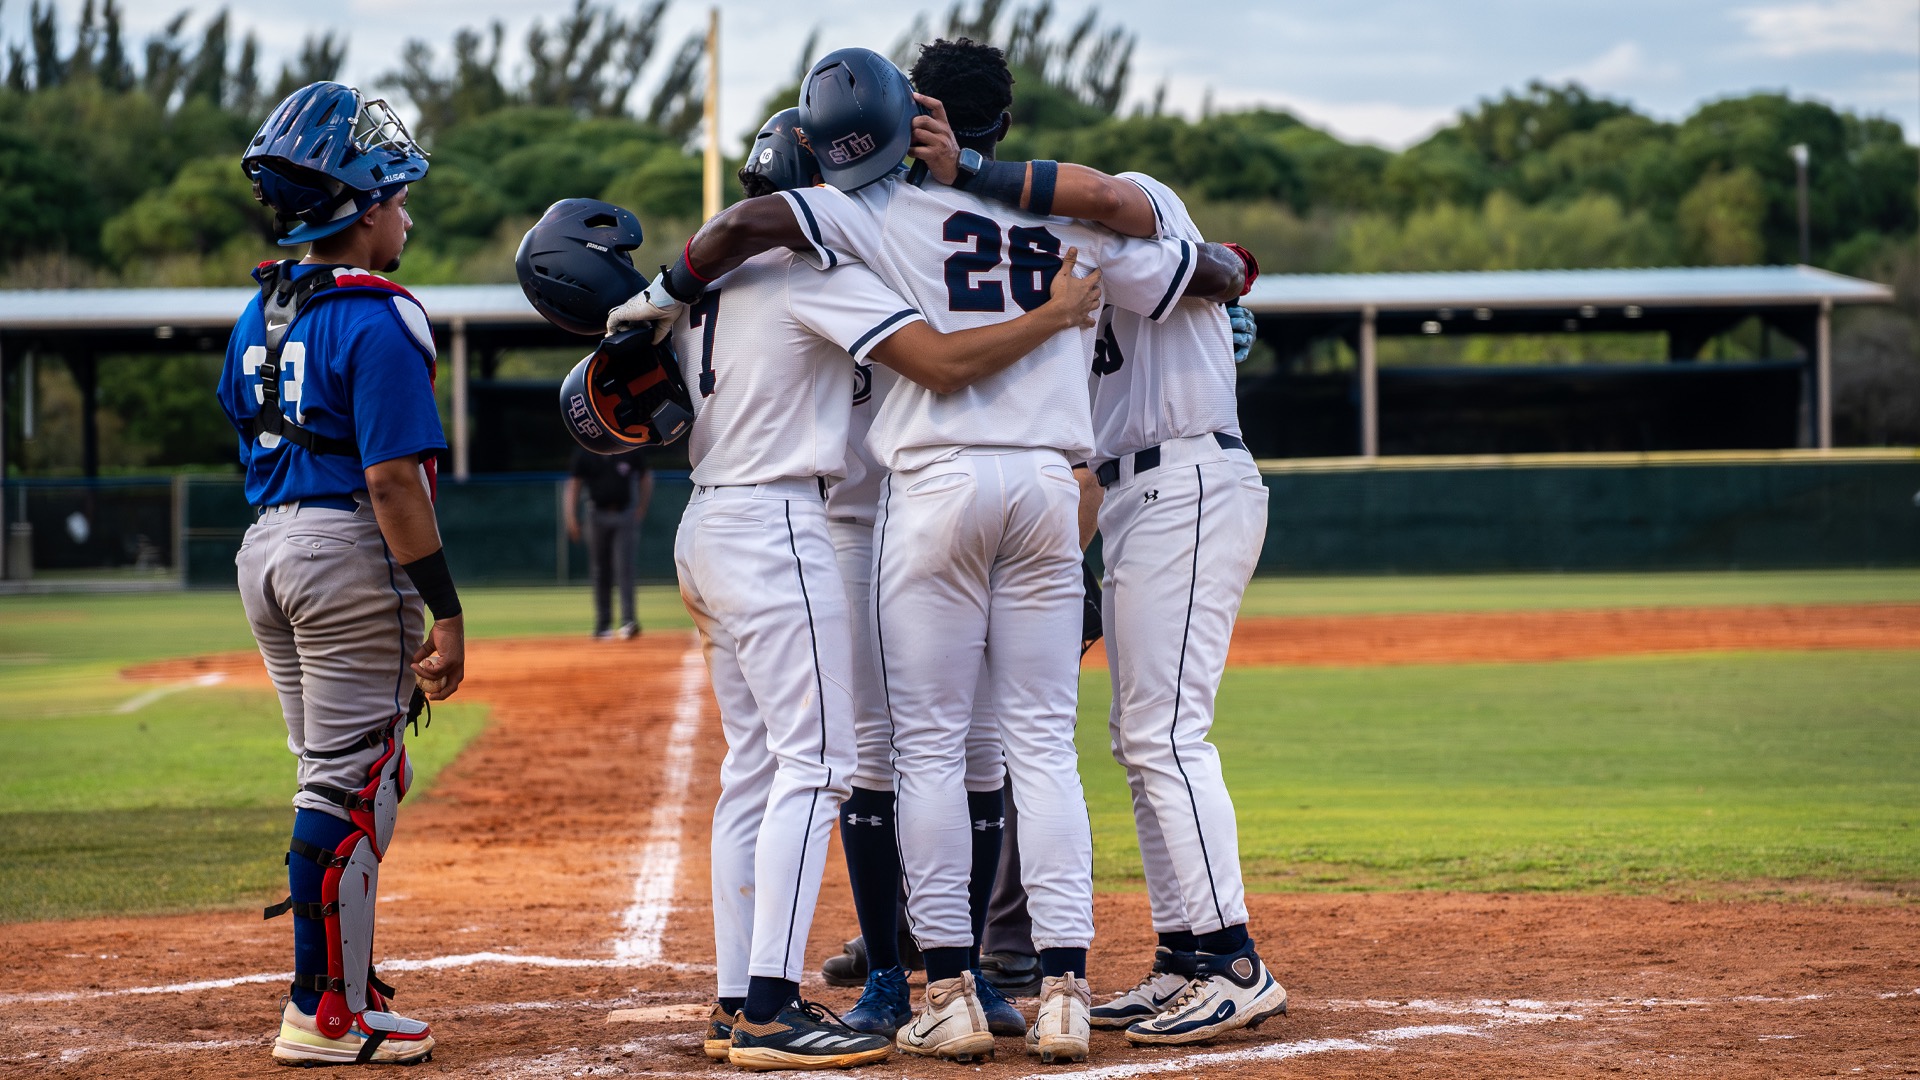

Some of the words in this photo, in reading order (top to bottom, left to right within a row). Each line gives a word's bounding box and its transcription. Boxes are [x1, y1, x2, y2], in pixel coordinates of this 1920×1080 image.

[943, 210, 1063, 313] 26
[690, 288, 722, 398] 7
[329, 1016, 340, 1026] 20
